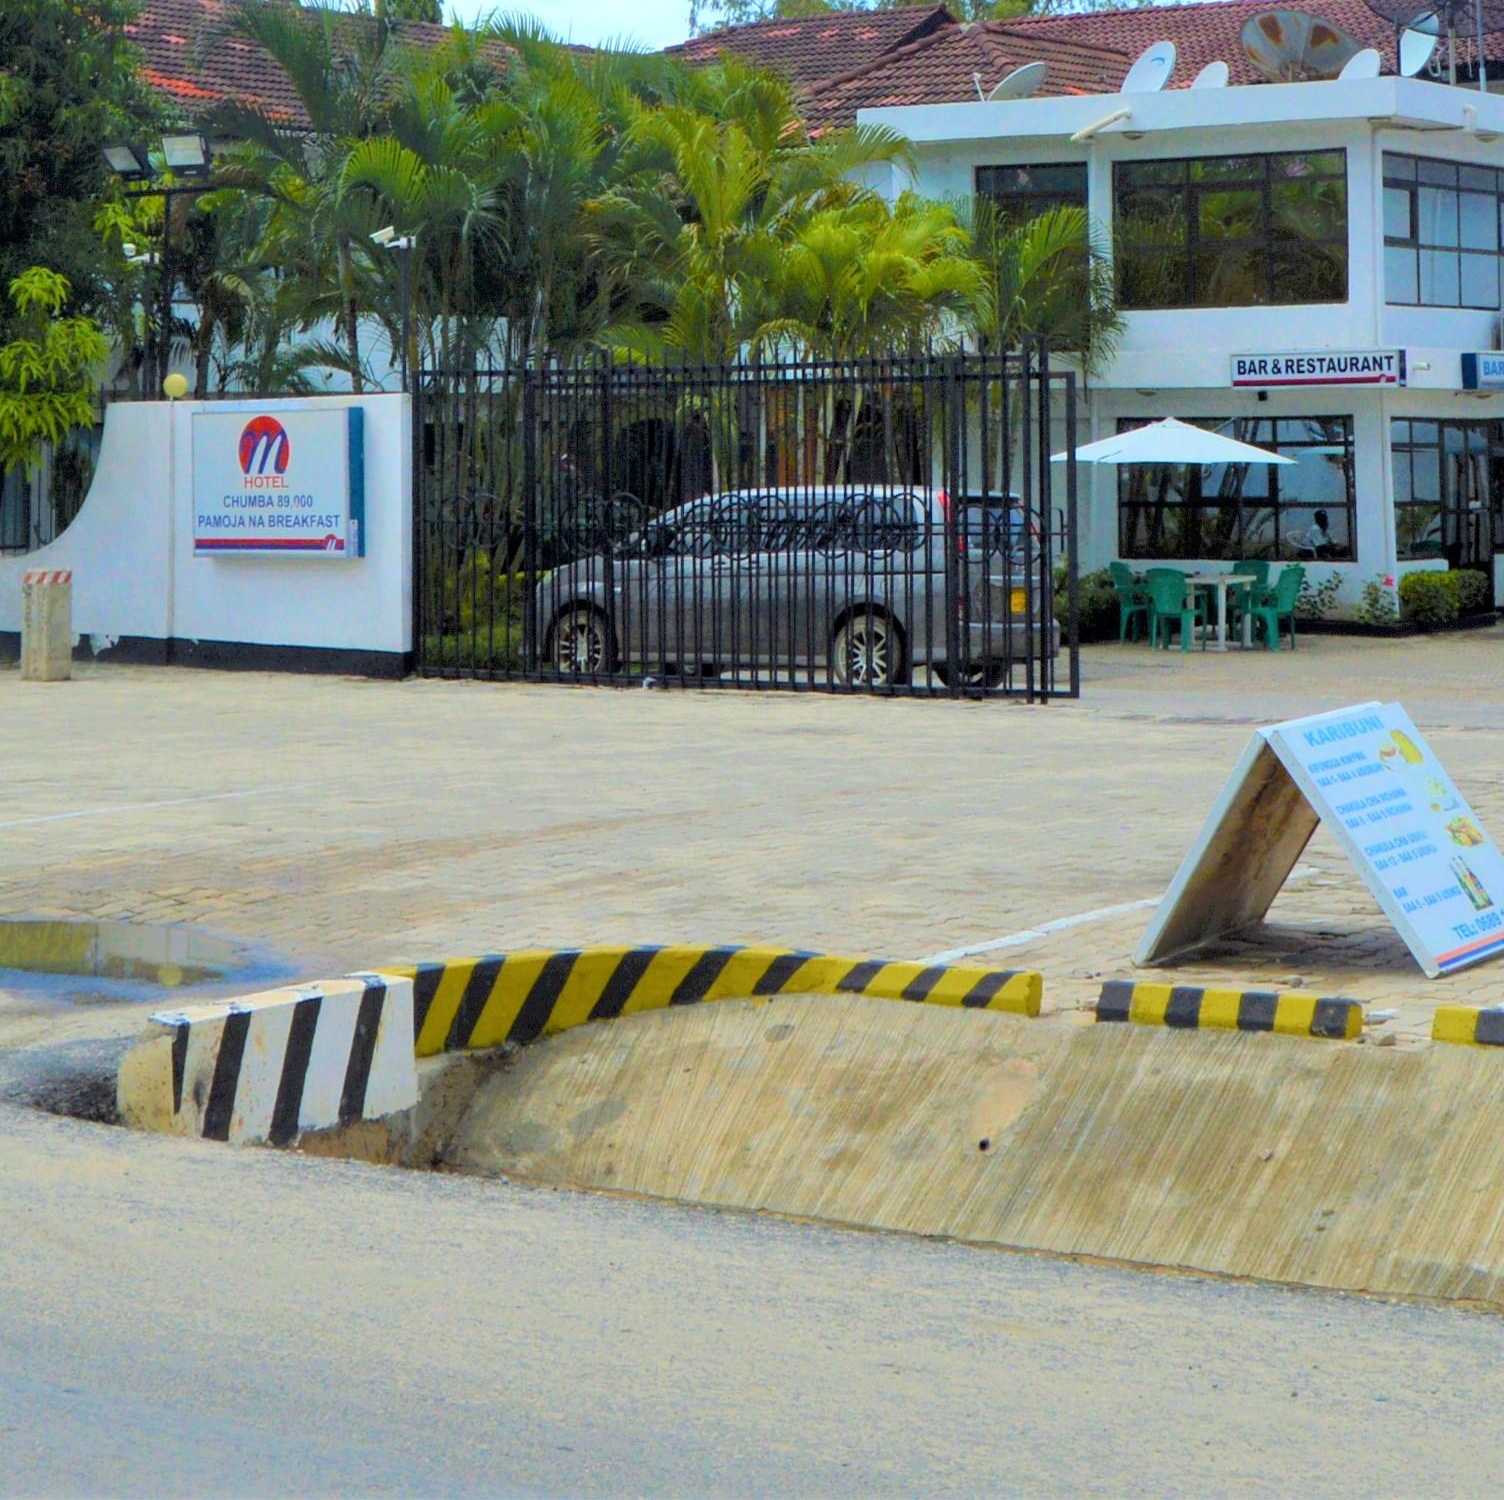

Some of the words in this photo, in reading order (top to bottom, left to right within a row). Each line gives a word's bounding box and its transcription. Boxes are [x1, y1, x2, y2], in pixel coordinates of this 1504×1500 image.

[1237, 359, 1268, 376] BAR
[1271, 359, 1282, 374] &
[1285, 355, 1394, 374] RESTAURANT
[1483, 361, 1504, 377] BAR
[244, 476, 289, 489] HOTEL
[223, 495, 273, 508] CHUMBA
[198, 515, 245, 528] PAMOJA
[249, 515, 265, 527] NA
[268, 514, 340, 528] BREAKFAST
[1304, 714, 1383, 747] KARIBUNI
[1453, 922, 1477, 939] TEL:
